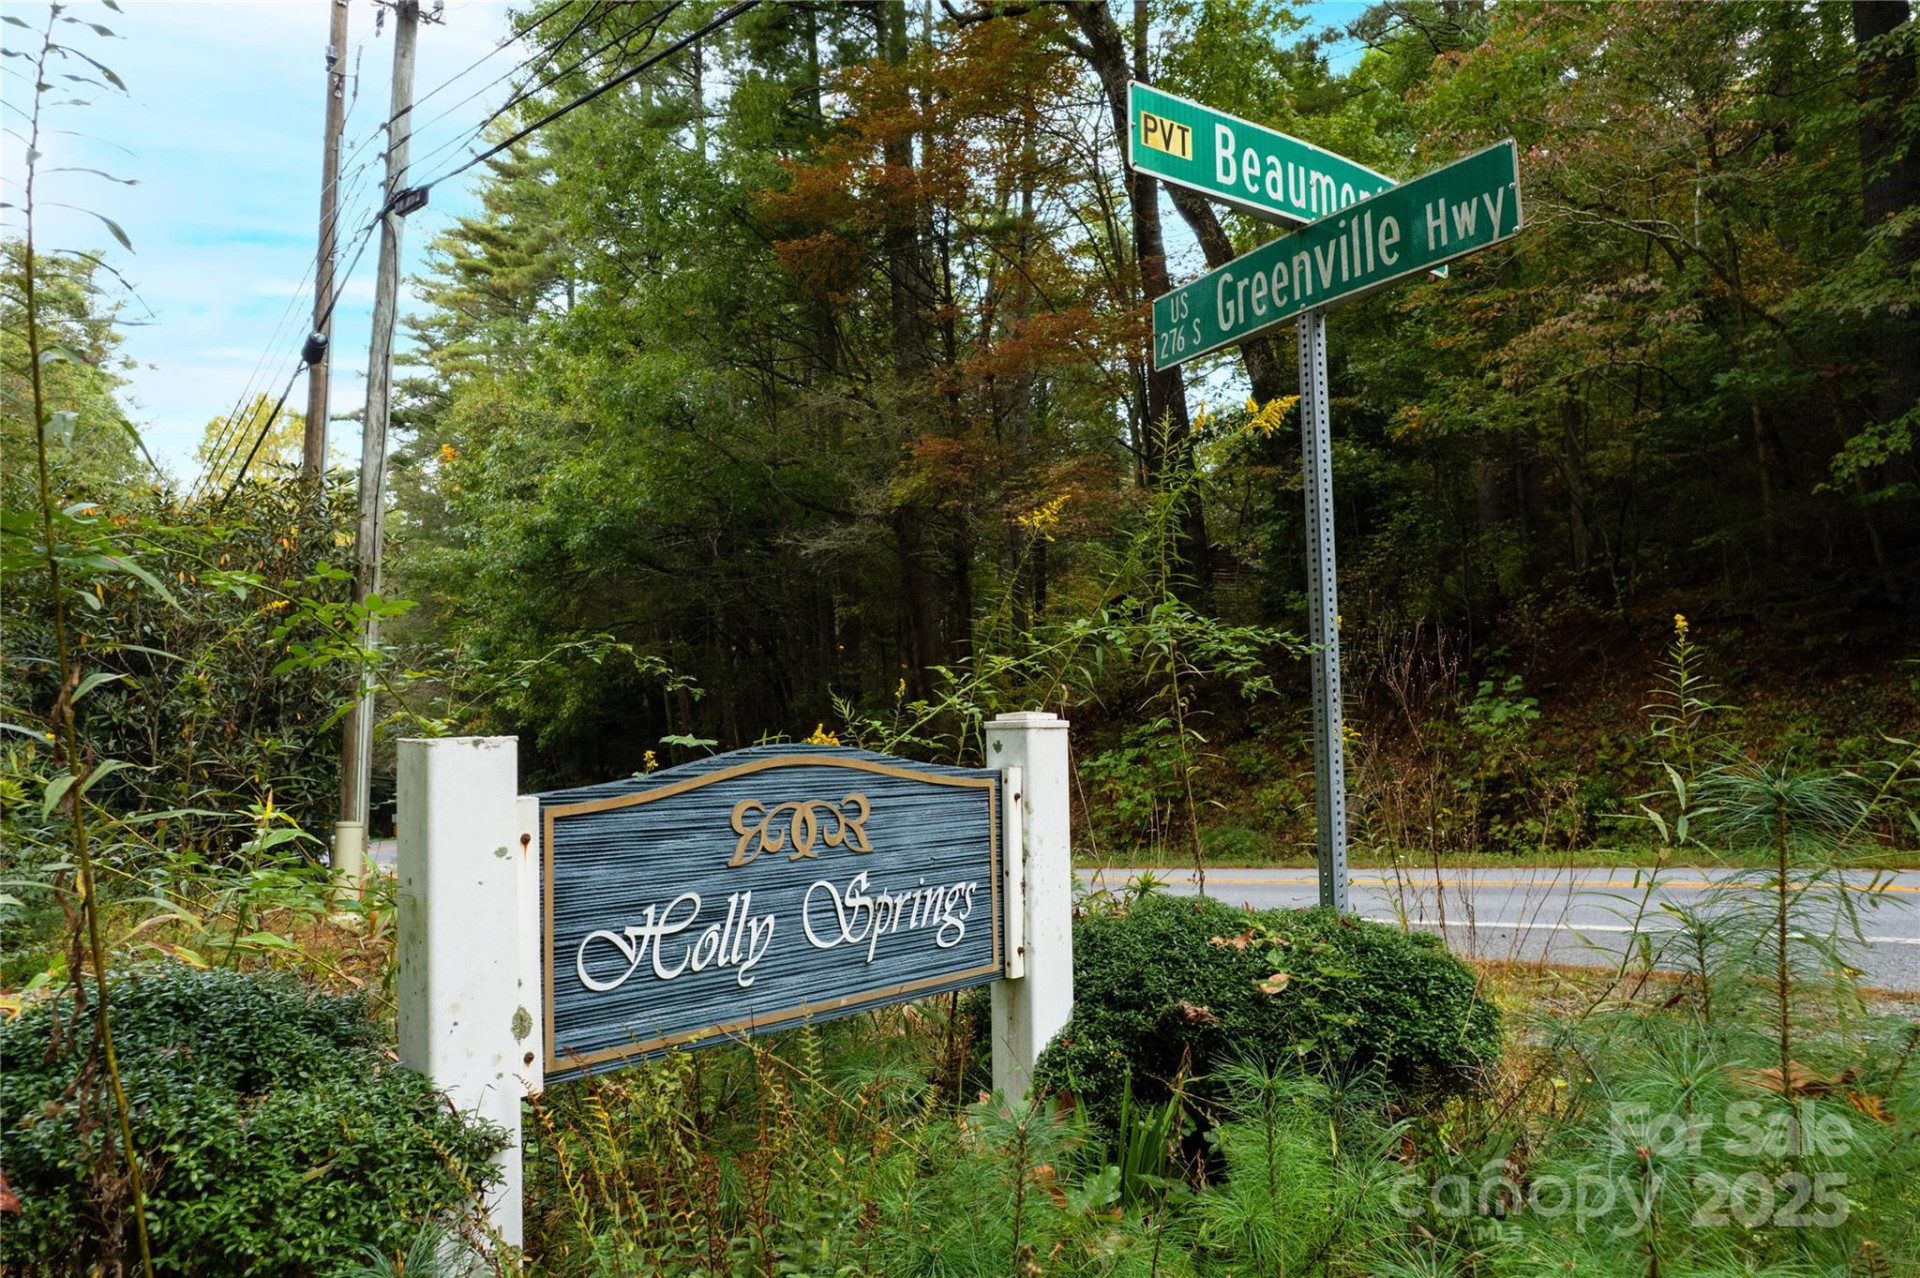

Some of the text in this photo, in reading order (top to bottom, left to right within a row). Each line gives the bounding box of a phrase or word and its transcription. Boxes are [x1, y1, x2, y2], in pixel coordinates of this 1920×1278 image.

[1142, 114, 1190, 158] PVT
[1217, 186, 1505, 332] Greenville Hwy
[1170, 292, 1188, 322] US
[1161, 317, 1201, 360] 276 S
[576, 870, 977, 991] Holly Springs
